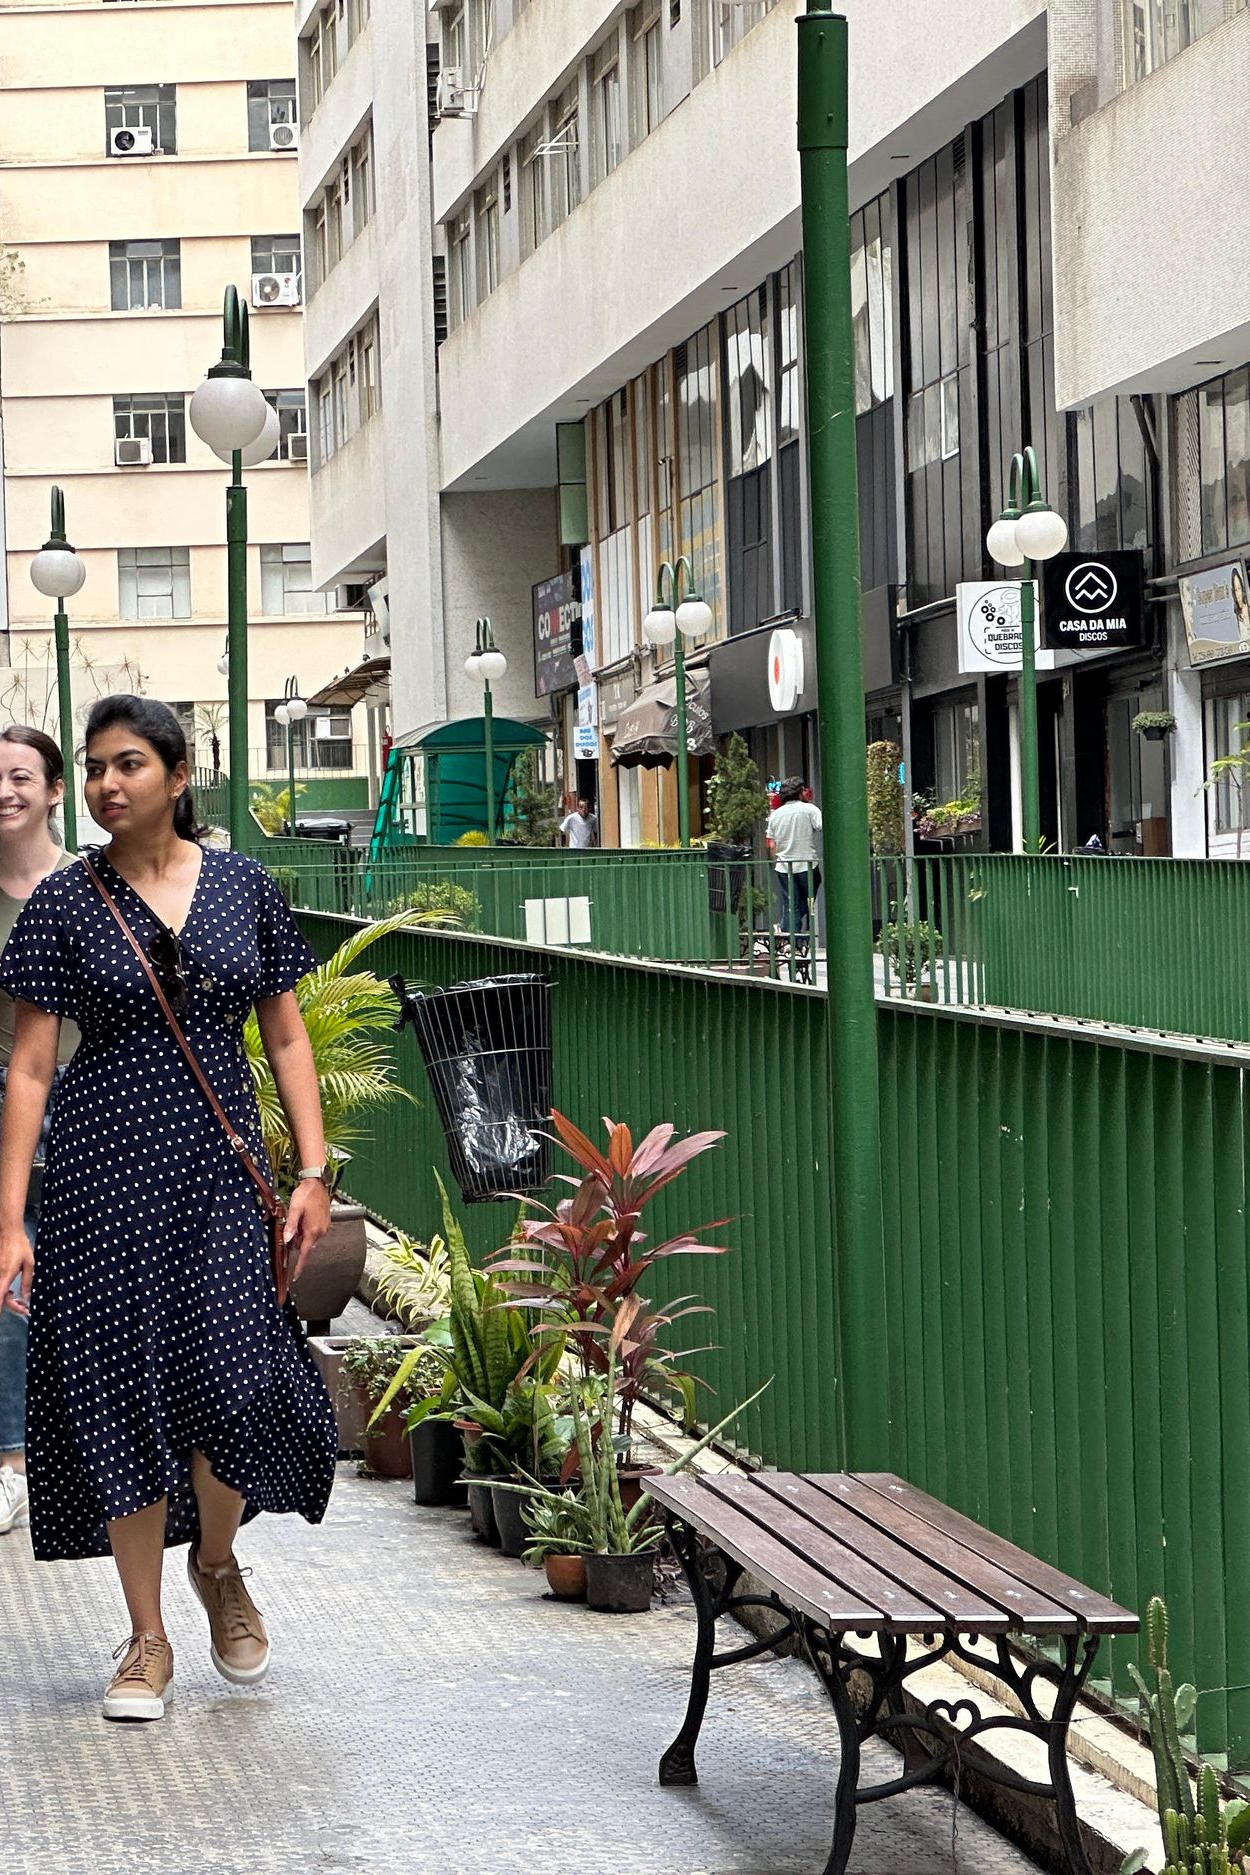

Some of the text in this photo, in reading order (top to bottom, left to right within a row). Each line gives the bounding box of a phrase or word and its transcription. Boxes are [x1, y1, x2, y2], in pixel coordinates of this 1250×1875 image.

[538, 601, 582, 640] CONNECTI
[1059, 618, 1127, 632] CASA DA MIA
[988, 633, 1023, 641] QUEBRAD
[1079, 632, 1108, 642] DISCOS
[995, 642, 1023, 651] DISCOS
